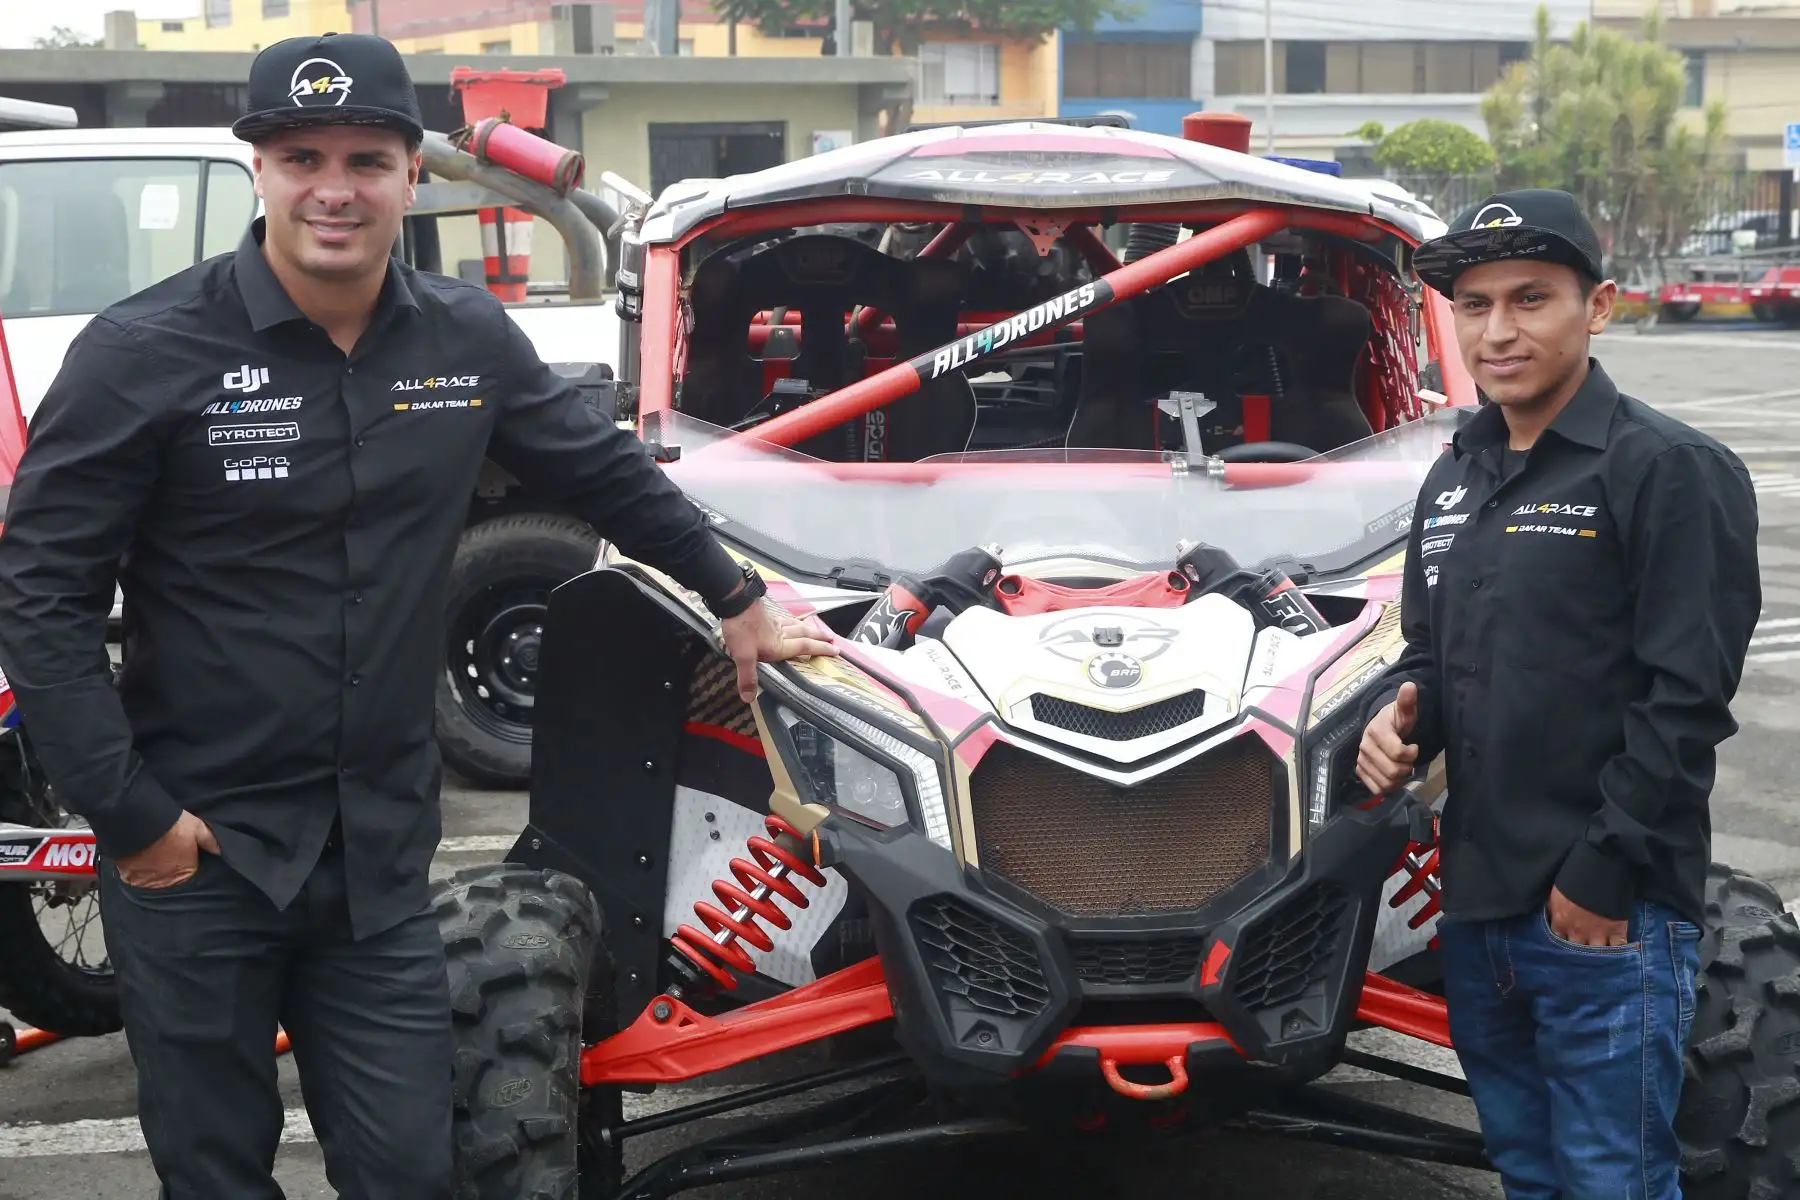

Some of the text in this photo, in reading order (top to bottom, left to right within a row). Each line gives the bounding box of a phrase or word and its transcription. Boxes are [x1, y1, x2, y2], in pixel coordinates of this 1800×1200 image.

[287, 76, 354, 98] A4R
[906, 169, 1176, 184] ALL4RACE
[931, 282, 1095, 379] ALL4DRONES
[390, 375, 481, 392] ALL4RACE
[200, 396, 304, 417] ALL4DRONES
[411, 399, 469, 411] DAKAR TEAM
[211, 426, 296, 441] PYROTECT
[223, 456, 288, 469] GoPro
[1510, 503, 1599, 517] ALL4RACE
[1517, 525, 1577, 536] DAKAR TEAM
[1110, 669, 1140, 677] BRP
